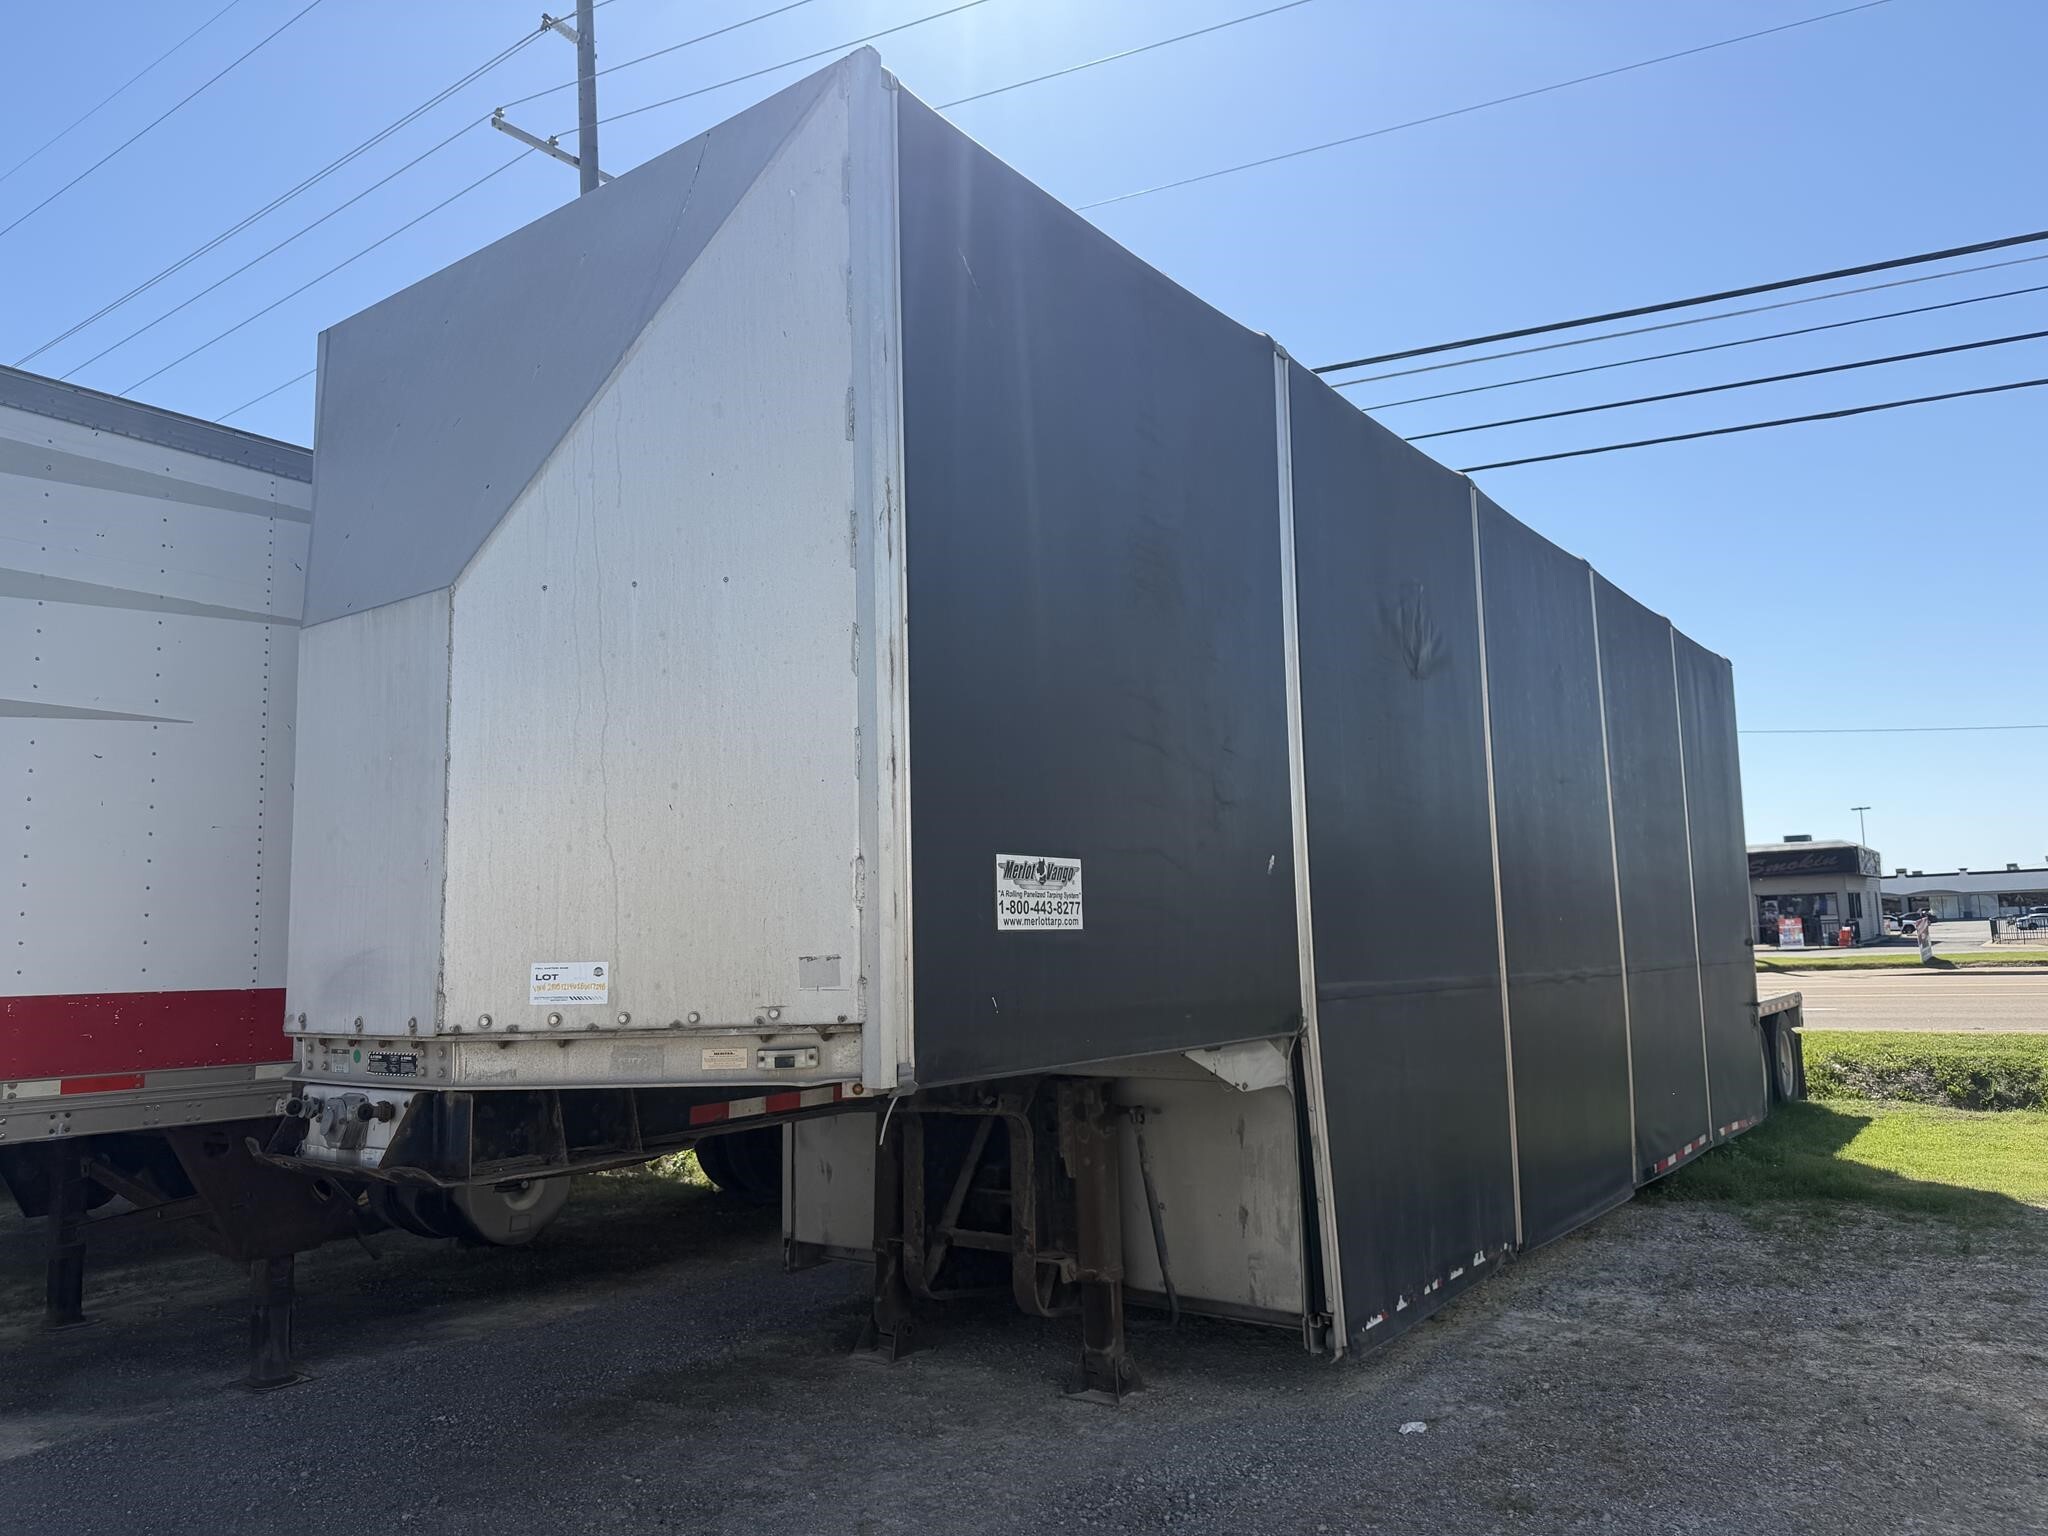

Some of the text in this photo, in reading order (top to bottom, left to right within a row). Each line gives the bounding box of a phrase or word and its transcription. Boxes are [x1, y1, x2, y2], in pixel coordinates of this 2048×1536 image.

[1003, 860, 1074, 882] Merlot Vango
[1006, 890, 1022, 899] Rolling
[1024, 890, 1046, 898] Panelized
[1047, 891, 1063, 900] Tarping
[999, 900, 1081, 915] 1-800-443-8277
[1003, 917, 1079, 927] www.merlottarp.com
